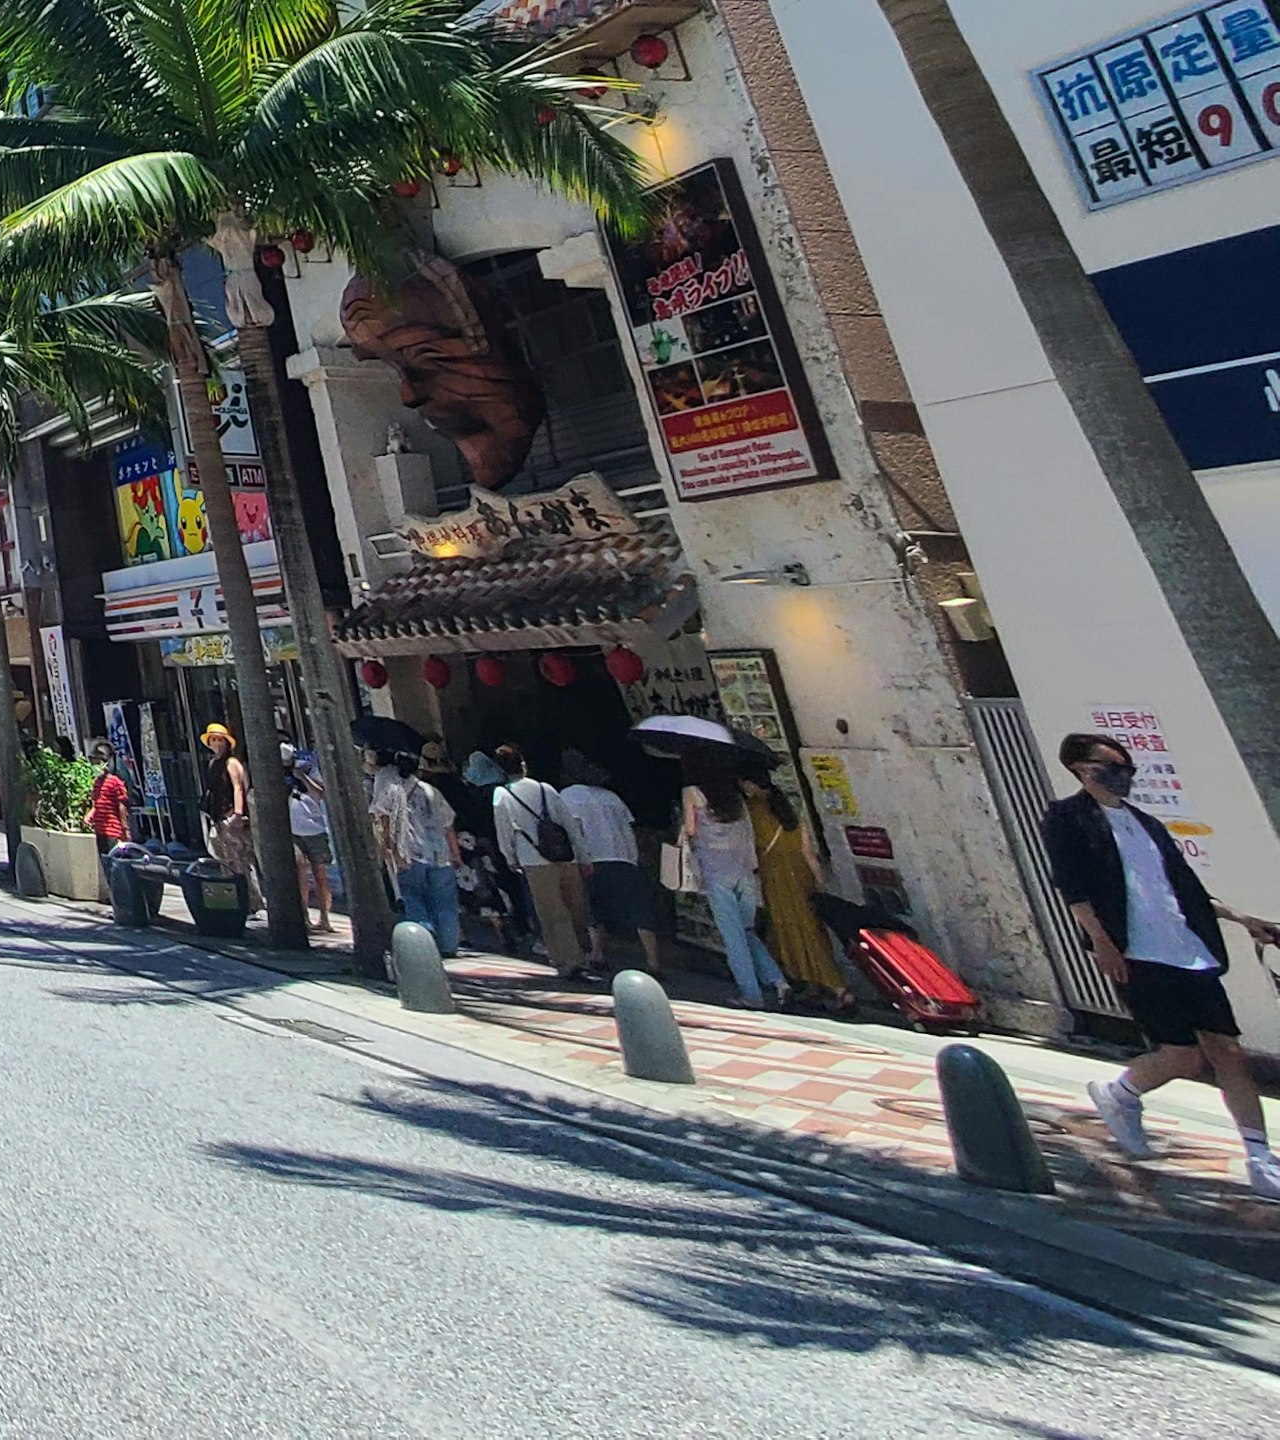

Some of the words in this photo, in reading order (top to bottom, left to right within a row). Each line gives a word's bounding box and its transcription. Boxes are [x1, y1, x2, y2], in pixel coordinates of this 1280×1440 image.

[1056, 8, 1280, 121] 抗原定量
[241, 468, 265, 484] ATM
[1091, 711, 1158, 730] 当日受付
[1105, 734, 1168, 752] 日検査
